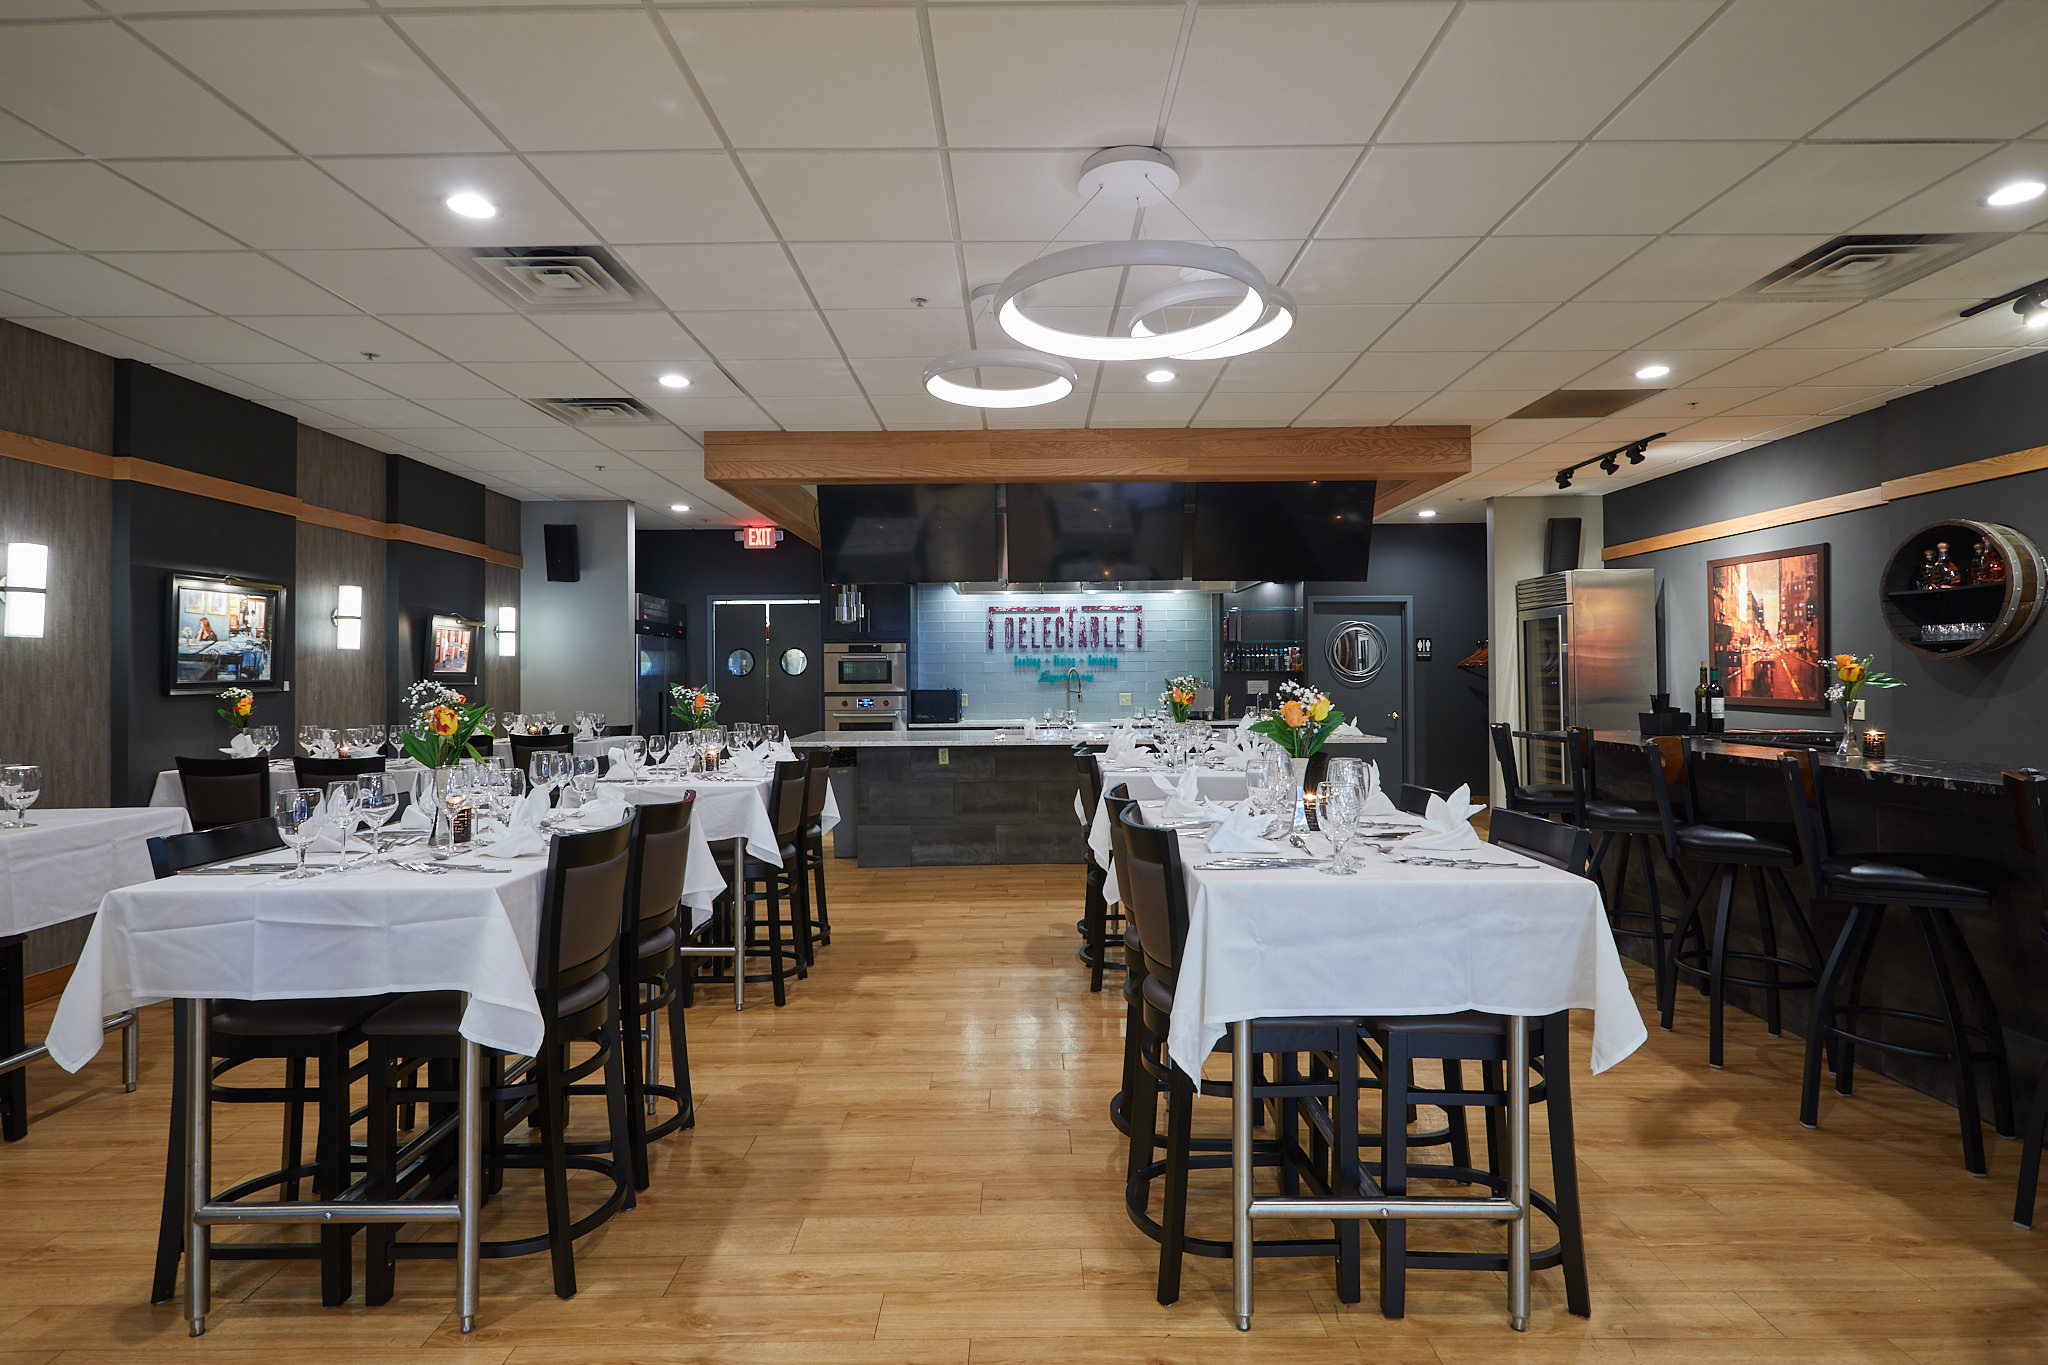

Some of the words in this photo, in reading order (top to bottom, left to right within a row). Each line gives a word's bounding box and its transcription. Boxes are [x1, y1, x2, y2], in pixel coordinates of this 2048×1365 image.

[748, 528, 772, 546] EXIT
[1004, 606, 1126, 649] DELECTABLE
[1014, 655, 1041, 670] Cooking
[1053, 654, 1076, 667] Dining
[1088, 654, 1118, 669] Drinking
